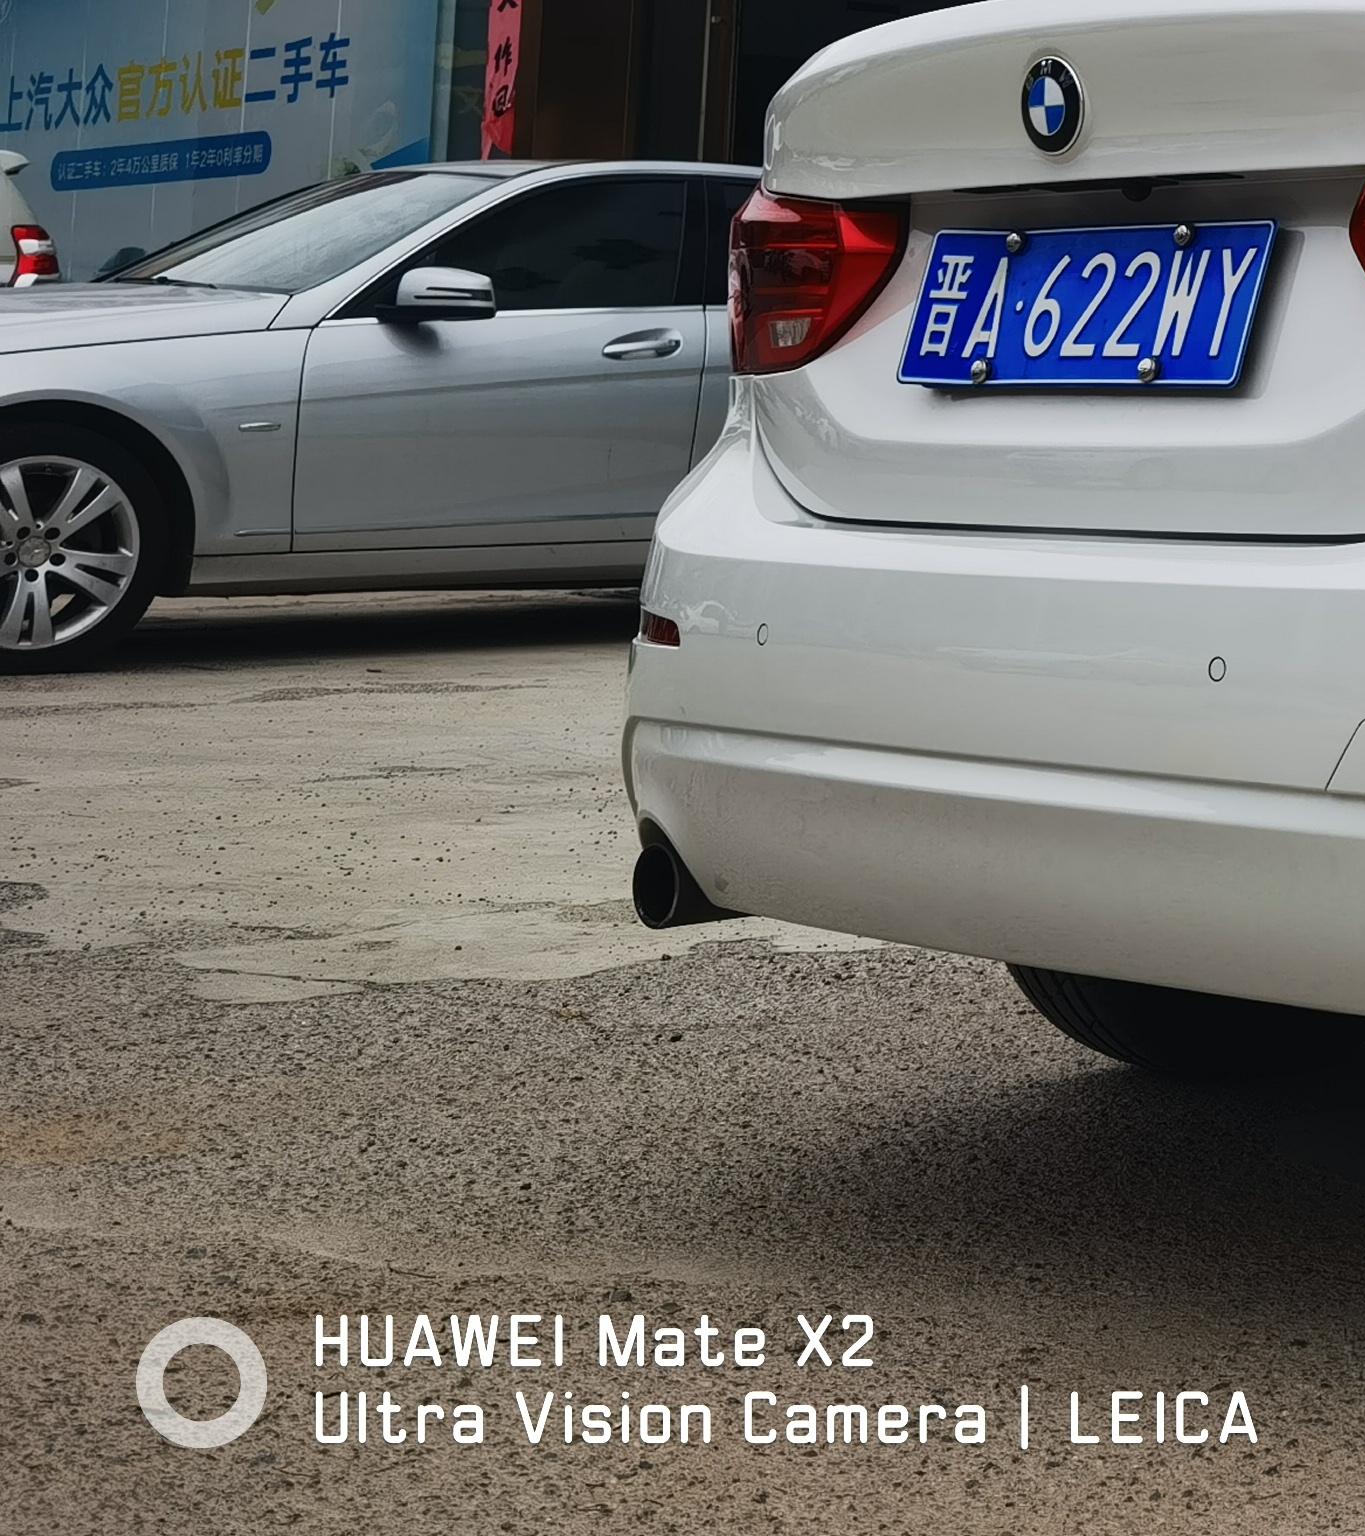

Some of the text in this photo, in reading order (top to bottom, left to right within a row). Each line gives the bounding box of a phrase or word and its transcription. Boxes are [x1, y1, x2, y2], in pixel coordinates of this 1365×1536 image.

[0, 32, 351, 132] 上汽大众官方认证二手车
